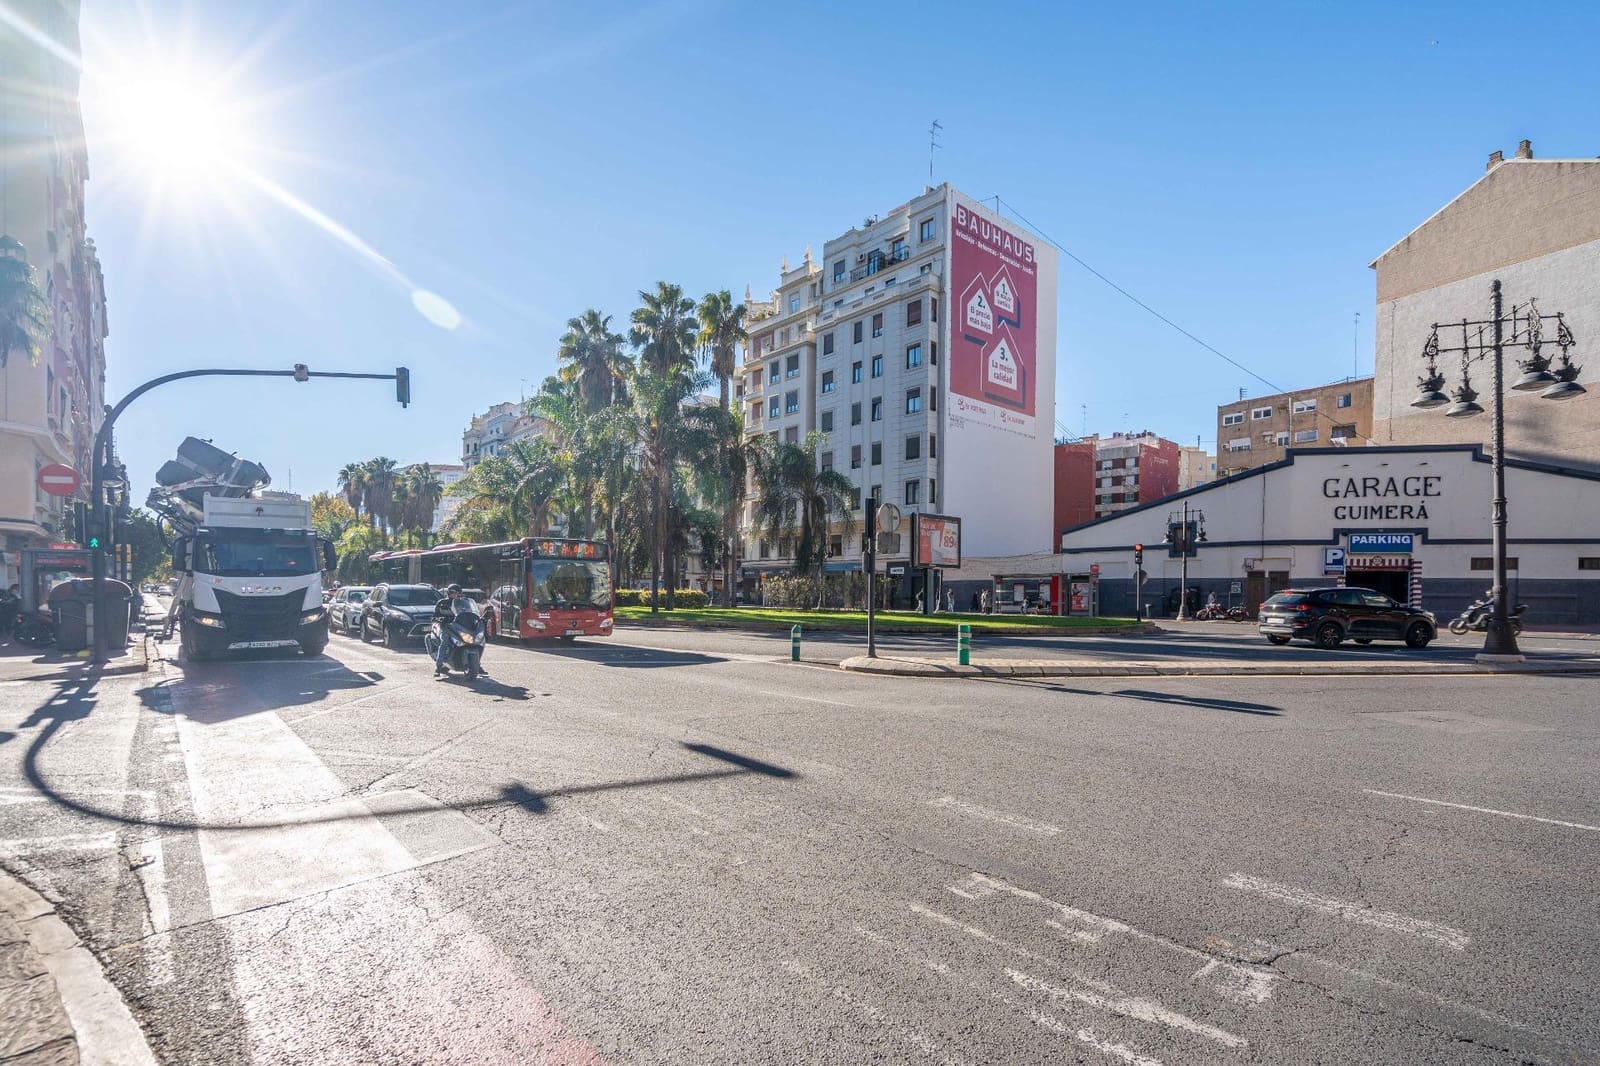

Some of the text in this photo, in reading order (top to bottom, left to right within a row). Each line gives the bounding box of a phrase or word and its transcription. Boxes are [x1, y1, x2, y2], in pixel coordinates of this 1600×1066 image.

[957, 207, 1032, 262] BAUHAUS
[977, 295, 986, 309] 2.
[976, 309, 991, 320] precio
[981, 320, 991, 330] bajo
[1000, 347, 1008, 361] 3.
[992, 359, 1015, 374] La mejor
[993, 372, 1013, 385] calidad
[1323, 476, 1441, 498] GARAGE
[1334, 500, 1429, 520] GUIMERÁ
[1351, 535, 1411, 544] PARKING
[1326, 549, 1344, 564] P
